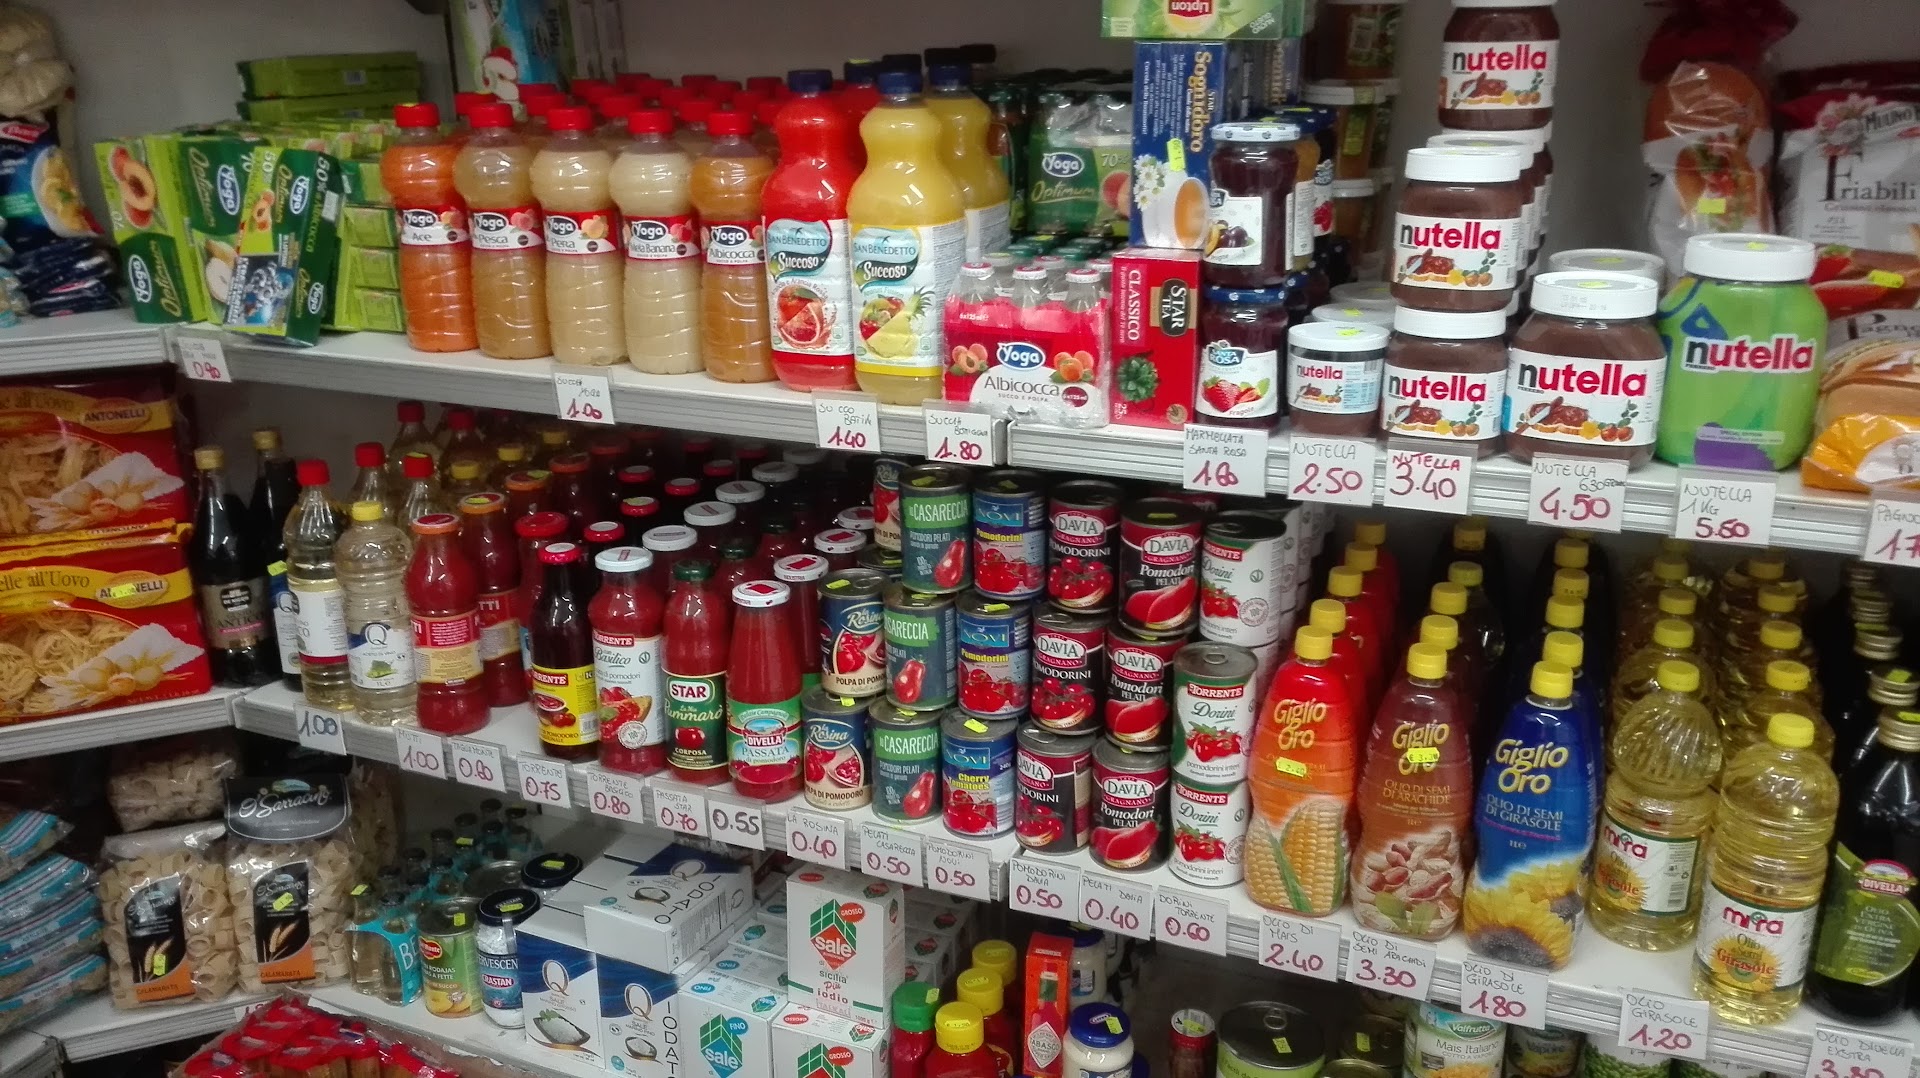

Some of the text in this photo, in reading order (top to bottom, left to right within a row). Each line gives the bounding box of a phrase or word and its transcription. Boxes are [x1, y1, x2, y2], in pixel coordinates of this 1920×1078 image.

[1171, 0, 1209, 13] Lipton
[1453, 44, 1547, 71] nutella
[1046, 155, 1081, 173] Yoga
[1819, 152, 1916, 201] Friabili
[405, 212, 434, 224] Yoga
[475, 214, 505, 231] Yoga
[550, 220, 574, 234] Yoga
[412, 233, 432, 242] Ace
[478, 234, 508, 244] Pesca
[634, 223, 664, 239] Yoga
[714, 228, 745, 246] Yoga
[1401, 222, 1502, 250] nutella
[646, 243, 676, 254] Banana
[782, 235, 828, 247] BENEDETTO
[867, 244, 916, 256] BENEDETTO
[710, 248, 756, 259] Albicocca
[778, 252, 819, 271] Succoso
[863, 265, 907, 281] Succoso
[1128, 270, 1141, 341] CLASSICO
[1162, 298, 1171, 319] TEA
[1171, 286, 1186, 328] STAR
[1002, 346, 1039, 366] Yoga
[1686, 338, 1814, 370] nutella
[1297, 364, 1343, 380] nutella
[1518, 363, 1647, 396] nutella
[985, 376, 1060, 397] Albicocca
[1389, 375, 1486, 401] nutella
[84, 409, 145, 422] ANTONELLI
[934, 437, 982, 461] 1.80
[1293, 443, 1356, 460] NUTELLA
[1393, 452, 1461, 471] NUTELLA
[1533, 463, 1596, 478] NUTELLA
[1293, 463, 1363, 494] 2.50
[1390, 462, 1457, 501] 3.40
[1683, 484, 1752, 502] NUTELLA
[914, 500, 968, 521] CASARECCIA
[1540, 487, 1611, 520] 4.50
[976, 528, 1023, 542] Pomodorini
[1058, 516, 1098, 535] DAVIA
[1150, 537, 1189, 553] DAVIA
[1140, 562, 1194, 578] Pomodori
[961, 648, 1009, 662] Pomodorini
[1040, 639, 1079, 657] DAVIA
[1117, 653, 1156, 672] DAVIA
[671, 684, 707, 698] STAR
[1111, 674, 1163, 694] Pomodori
[1190, 684, 1243, 698] TORRENTE
[1192, 702, 1236, 719] Dorini
[1274, 697, 1327, 728] Giglio
[300, 711, 338, 737] 1.00
[810, 725, 850, 742] Rosina
[748, 736, 781, 746] DIVELLA
[884, 733, 939, 754] CASARECCIA
[1277, 726, 1315, 750] Oro
[1392, 719, 1449, 750] Giglio
[403, 746, 439, 770] 1.00
[675, 748, 707, 756] CORPOSA
[742, 746, 789, 757] PASSATA
[1496, 739, 1569, 771] Giglio
[526, 776, 562, 801] 0.75
[958, 774, 990, 784] Cherry
[1107, 780, 1148, 796] DAVIA
[1498, 768, 1550, 794] Oro
[593, 791, 631, 816] 0.80
[826, 790, 864, 800] POMODORO
[1101, 802, 1154, 819] Pomodori
[1178, 802, 1220, 823] Dorini
[1487, 793, 1563, 822] OLIO DI SEMI
[661, 807, 698, 831] 0.70
[712, 808, 761, 836] 0.55
[1499, 809, 1562, 831] GIRASOLE
[791, 831, 838, 859] 0.40
[866, 852, 911, 876] 0.50
[935, 866, 976, 887] 0.50
[1863, 879, 1903, 892] DIVELLA
[1016, 884, 1063, 910] 0.50
[841, 907, 863, 916] GROSSO
[1085, 899, 1140, 930] 0.40
[1723, 906, 1784, 935] mira
[1165, 916, 1211, 942] 0.60
[815, 936, 852, 958] sale
[1264, 943, 1324, 972] 2.40
[1716, 948, 1775, 976] Girasole
[819, 970, 847, 984] sicilia
[1356, 958, 1417, 989] 3.30
[625, 983, 652, 1021] Q
[817, 988, 849, 1004] iodio
[729, 1022, 746, 1030] FINO
[1452, 1023, 1490, 1032] Valfrutta
[1436, 1039, 1498, 1053] Mais Italiano
[1628, 1023, 1693, 1050] 1.20
[703, 1048, 739, 1070] sale
[828, 1051, 851, 1060] GROSSO
